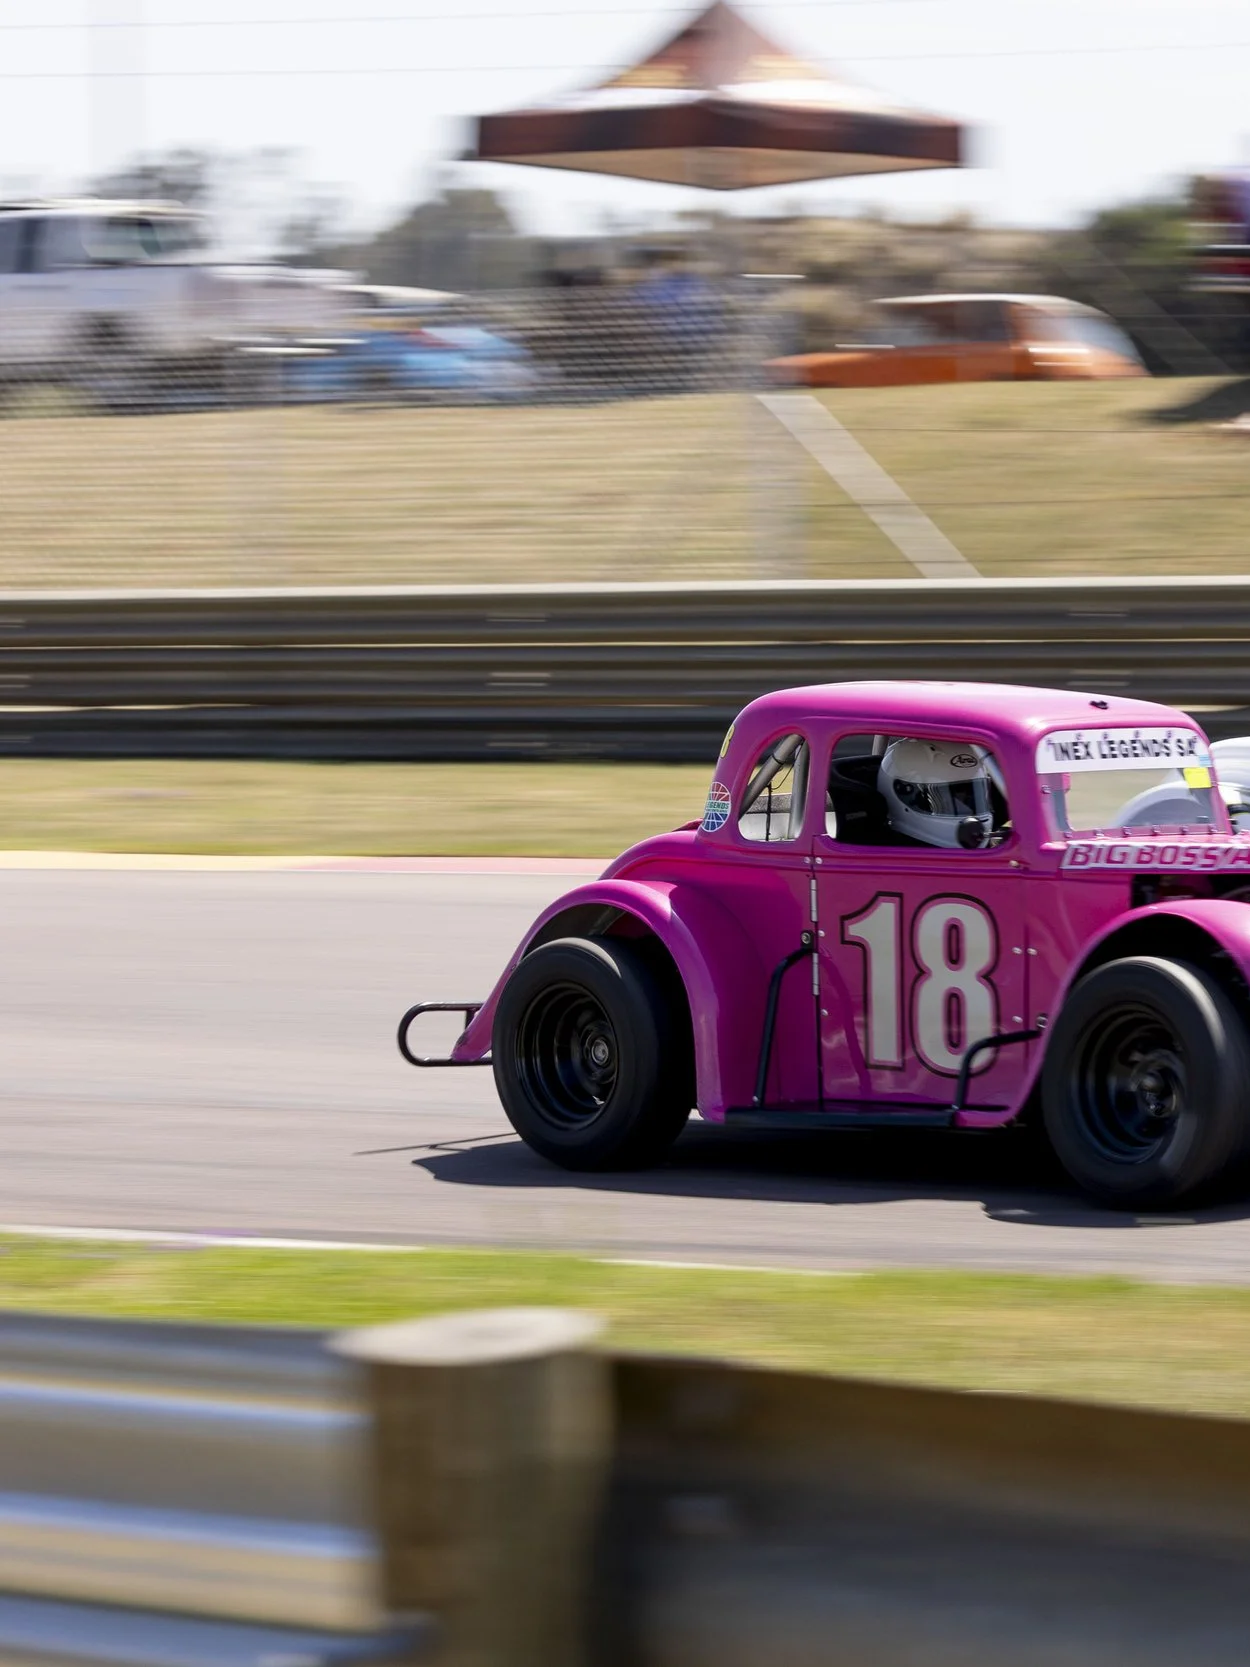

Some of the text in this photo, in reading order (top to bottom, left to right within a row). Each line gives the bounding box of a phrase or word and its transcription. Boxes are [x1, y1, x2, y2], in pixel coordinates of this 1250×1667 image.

[1053, 741, 1094, 761] INEX
[1097, 738, 1171, 760] LEGENDS
[1060, 841, 1130, 869] BIG
[1132, 842, 1221, 870] BOSS
[839, 891, 1000, 1079] 18
